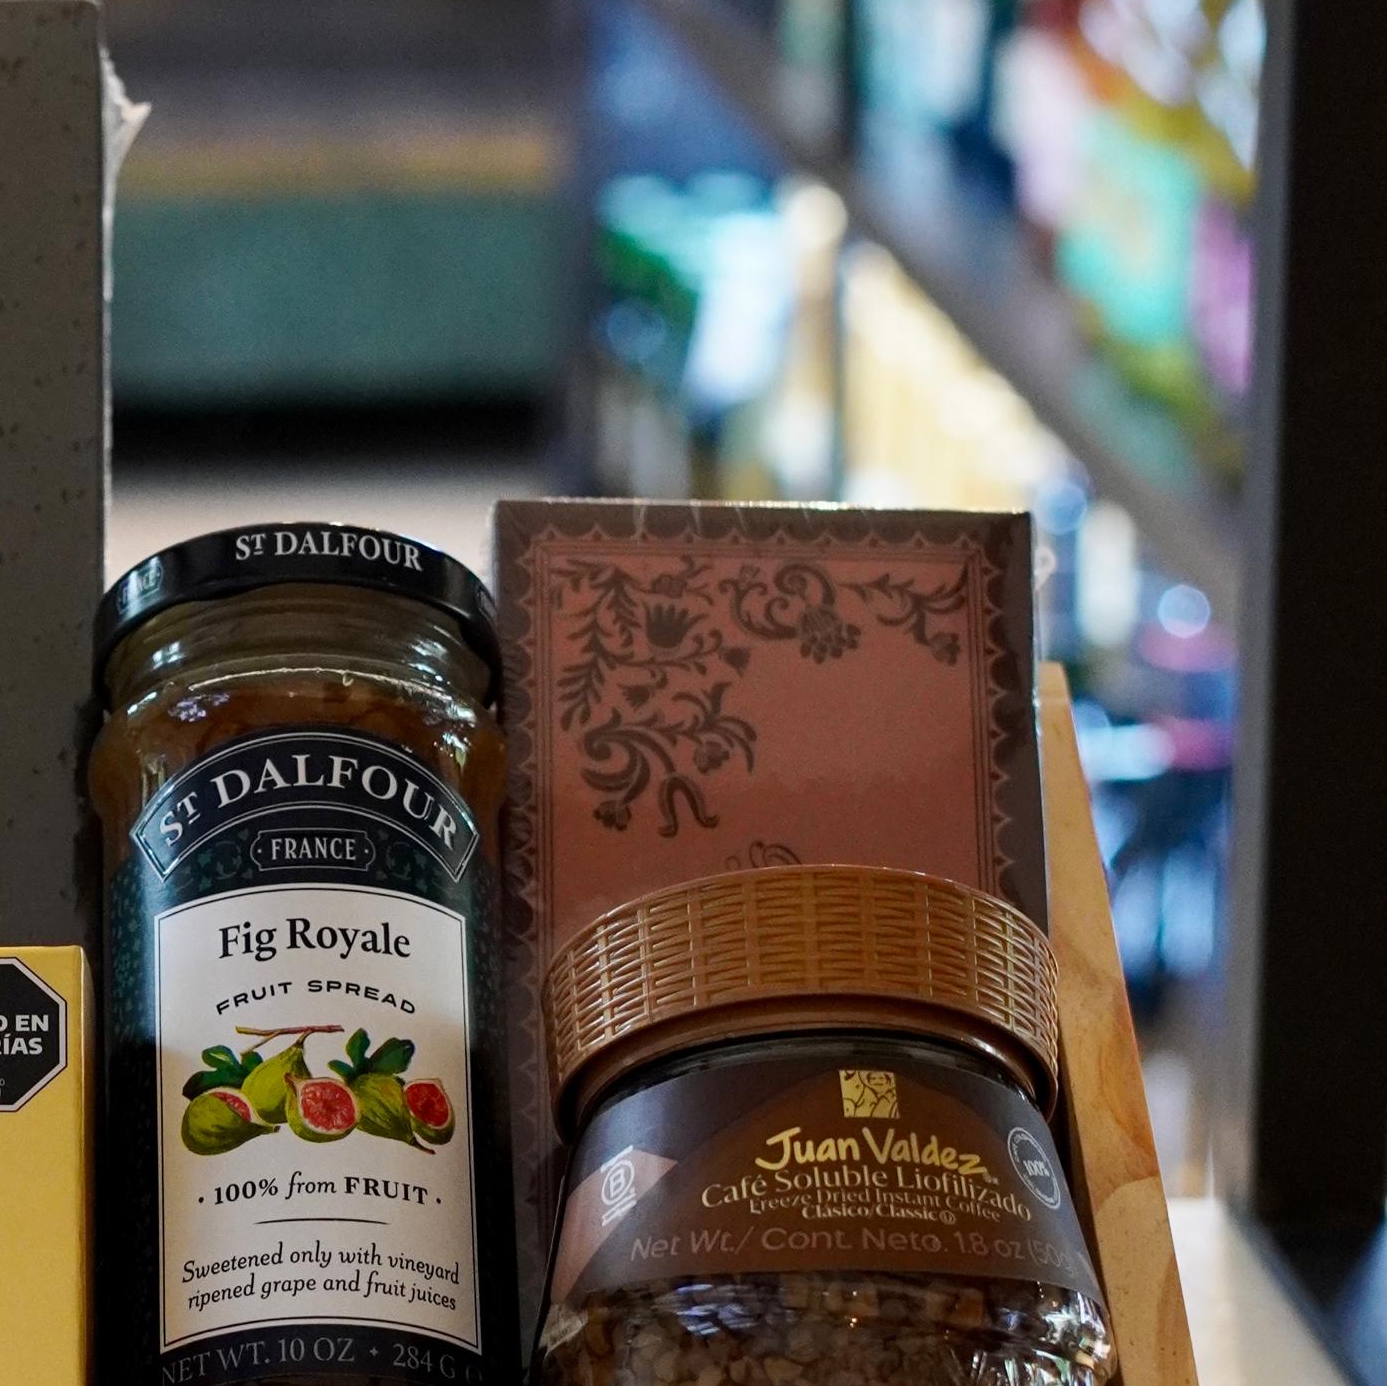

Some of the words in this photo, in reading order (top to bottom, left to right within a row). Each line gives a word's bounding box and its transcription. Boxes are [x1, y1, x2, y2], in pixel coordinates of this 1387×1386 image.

[274, 530, 422, 572] DALFOUR
[210, 753, 459, 850] DALFOUR
[270, 837, 357, 861] FRANCE
[218, 920, 278, 962] Fig
[285, 917, 412, 960] Royale
[216, 981, 293, 1016] FRUIT
[307, 980, 416, 1015] SPREAD
[15, 1014, 49, 1032] EN
[755, 1126, 860, 1171] Juan
[861, 1126, 988, 1178] Valdez
[214, 1177, 279, 1205] 100%
[285, 1170, 337, 1201] from
[344, 1175, 429, 1205] FRUIT
[701, 1172, 768, 1210] Café
[774, 1165, 889, 1194] Soluble
[896, 1165, 1032, 1222] Liofilizado
[816, 1188, 872, 1205] Dried
[875, 1188, 941, 1208] Instant
[945, 1197, 1001, 1223] Coffee
[181, 1241, 283, 1284] Sweetened
[290, 1240, 332, 1268] only
[338, 1242, 381, 1266] with
[387, 1253, 461, 1285] vineyard
[630, 1236, 681, 1262] Net
[953, 1230, 990, 1256] 1.8
[994, 1239, 1025, 1259] oz
[188, 1273, 255, 1313] ripened
[261, 1276, 316, 1300] grape
[323, 1269, 360, 1292] and
[362, 1270, 406, 1298] fruit
[408, 1283, 457, 1311] juices
[215, 1340, 271, 1370] WT.
[278, 1338, 306, 1363] 10
[313, 1337, 356, 1363] OZ
[392, 1343, 434, 1373] 284
[440, 1354, 456, 1380] G
